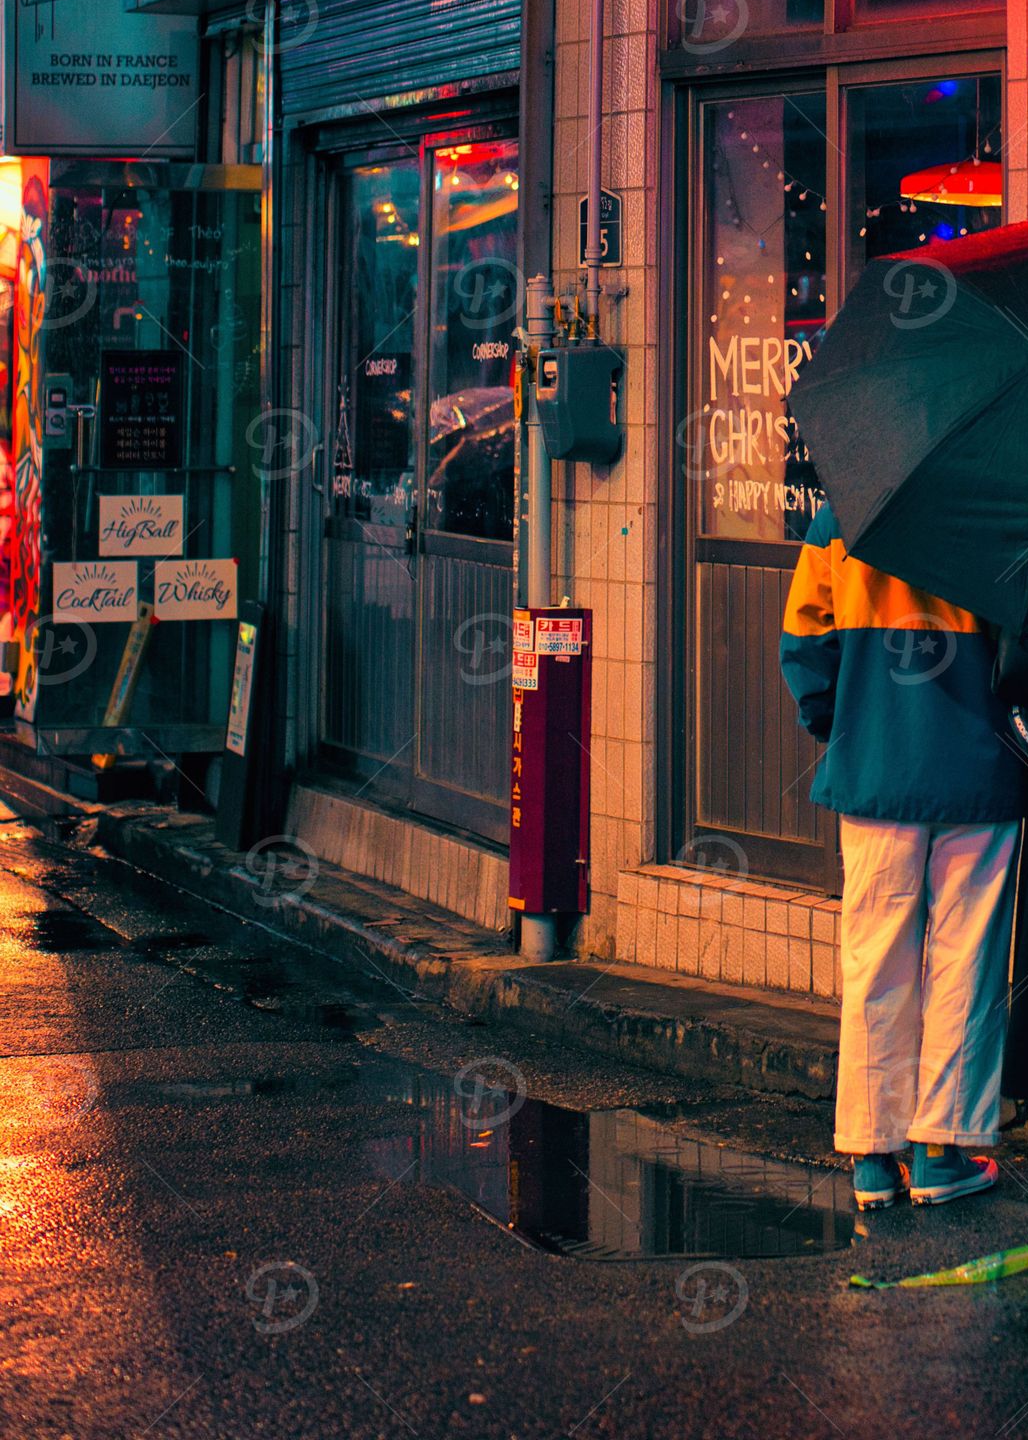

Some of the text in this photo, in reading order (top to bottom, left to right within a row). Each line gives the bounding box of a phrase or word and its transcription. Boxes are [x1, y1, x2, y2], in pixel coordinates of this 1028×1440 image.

[50, 54, 178, 68] BORN IN FRANCE
[31, 74, 191, 89] BREWED IN DAEJEON
[158, 579, 233, 610] Whisky
